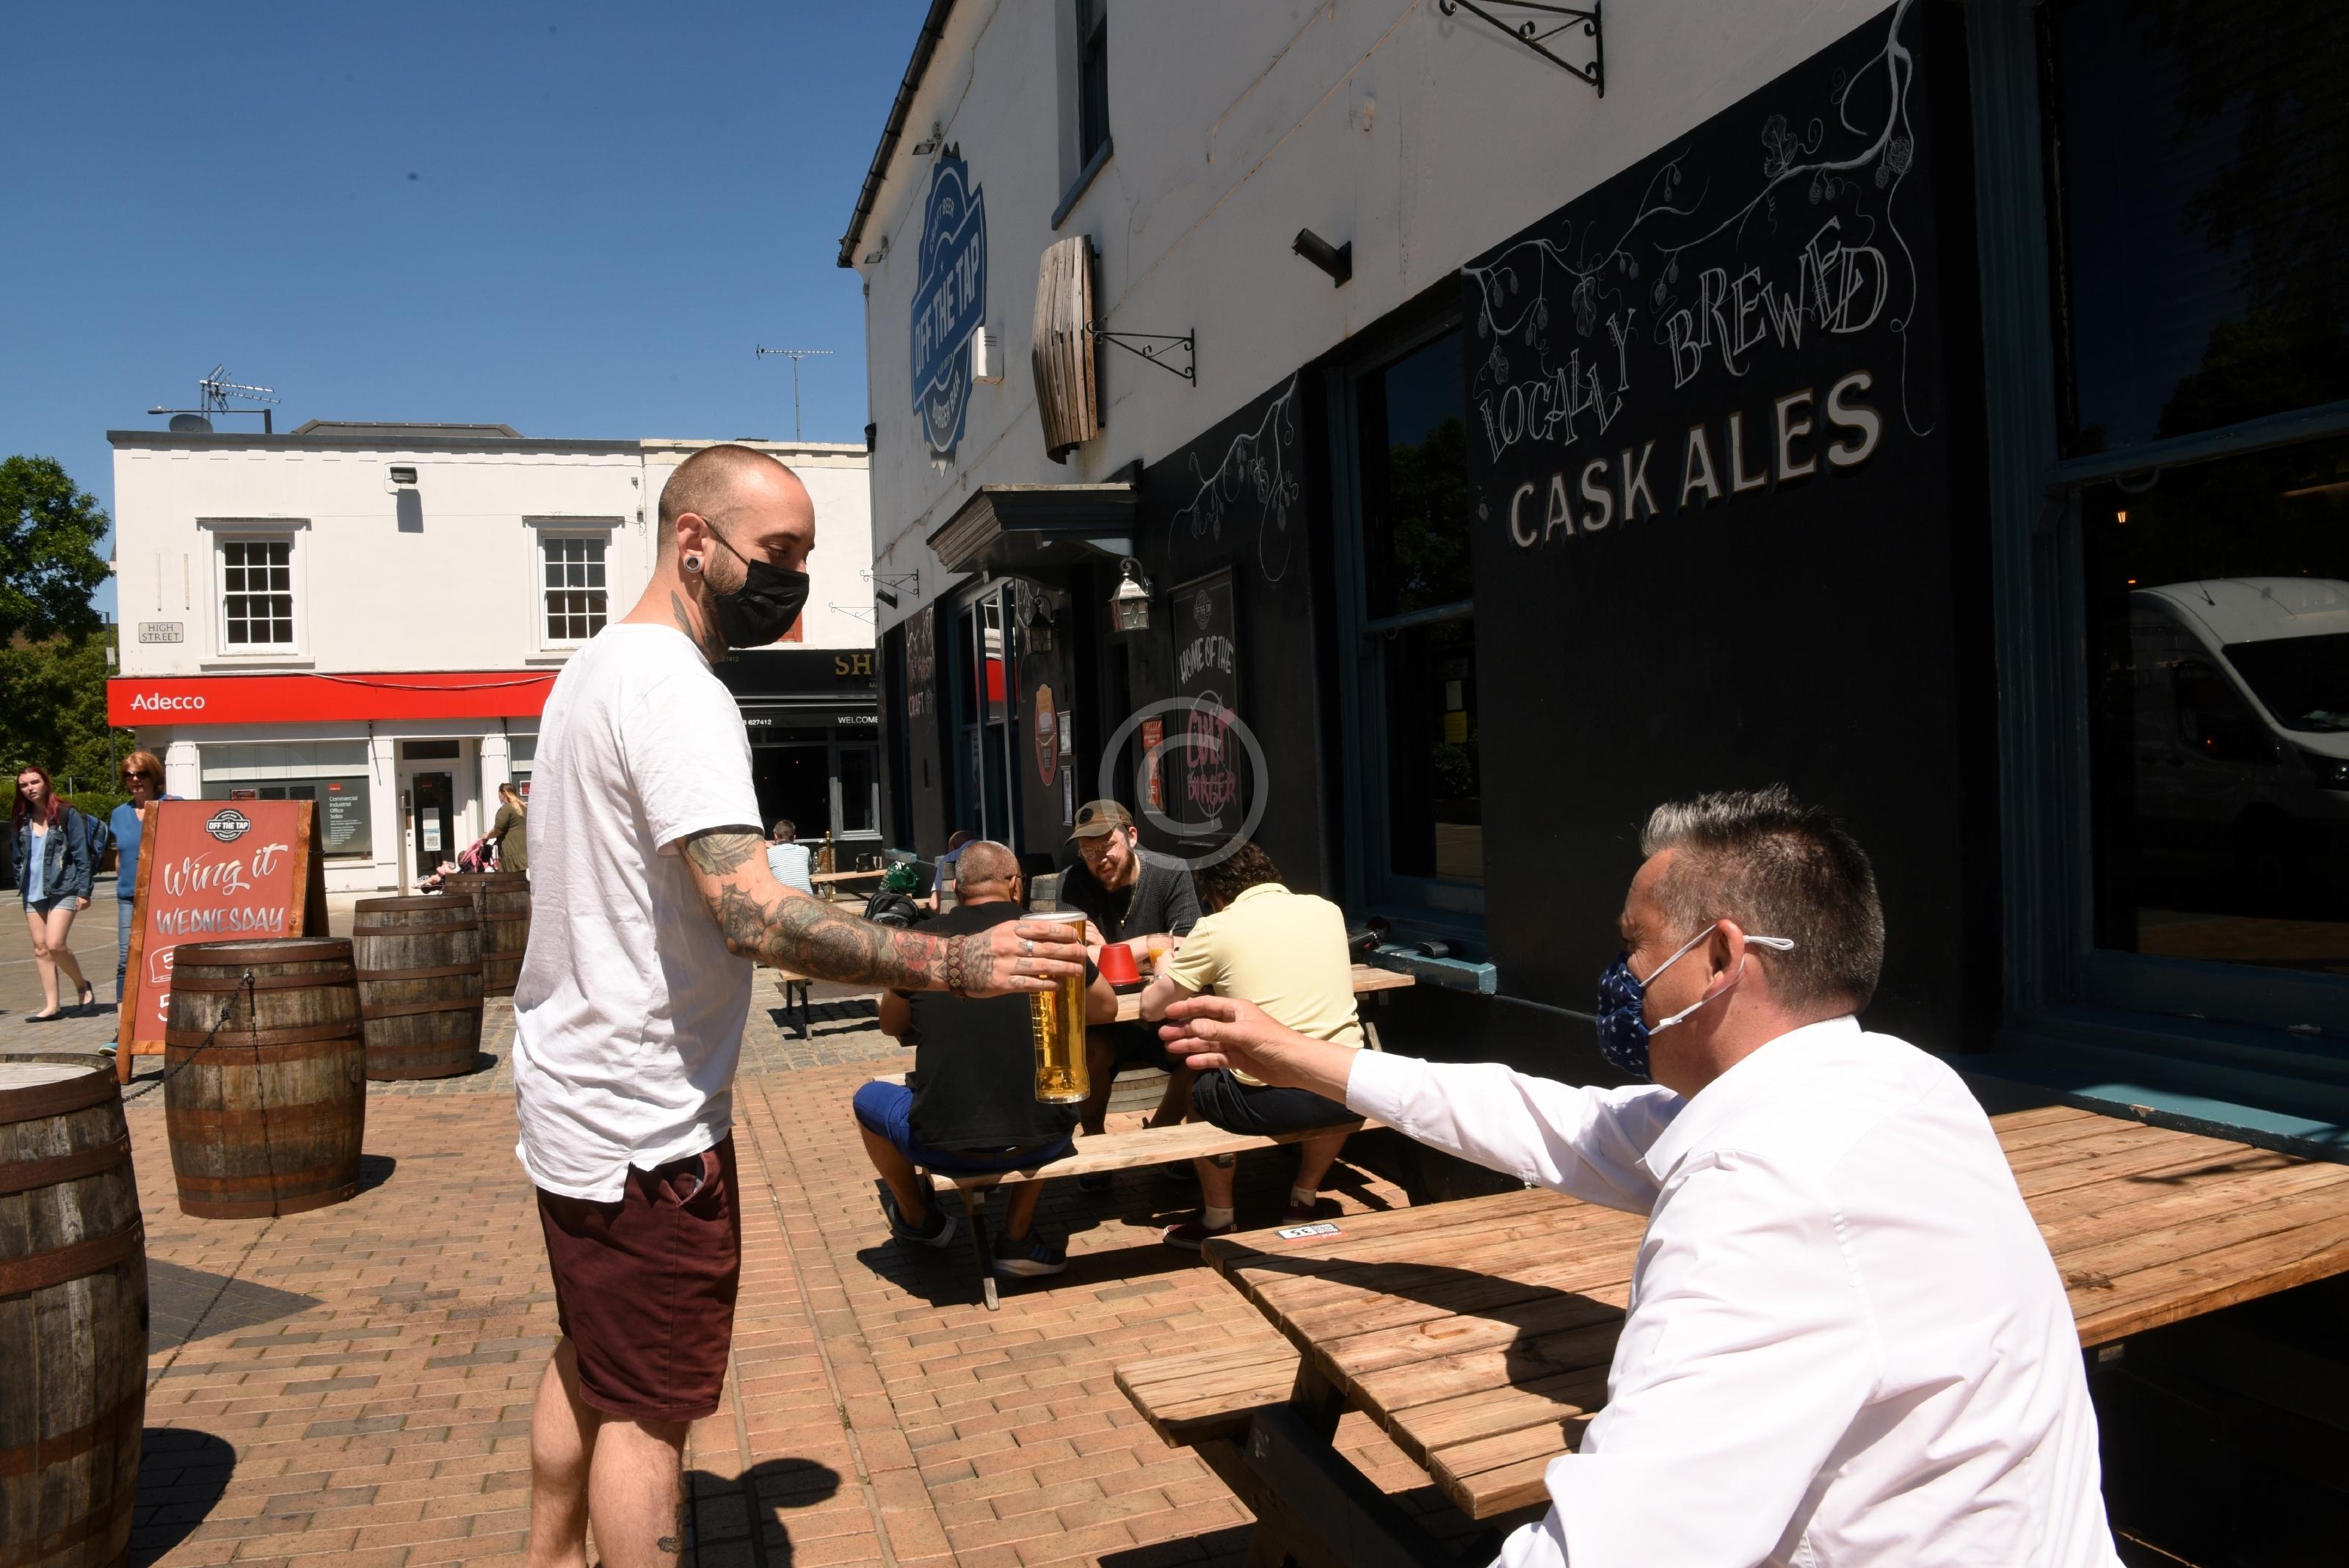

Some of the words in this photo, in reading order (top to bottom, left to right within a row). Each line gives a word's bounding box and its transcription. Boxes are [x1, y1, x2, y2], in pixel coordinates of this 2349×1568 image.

[929, 203, 942, 255] CRAFT
[943, 197, 954, 218] BEER
[915, 302, 931, 378] OFF
[933, 269, 955, 349] THE
[956, 231, 979, 317] TAP
[1480, 308, 1636, 463] LOCALLY
[1666, 217, 1888, 390] BREWED
[950, 369, 961, 414] BAR
[1510, 440, 1658, 548] CASK
[1680, 370, 1883, 508] ALES
[142, 633, 179, 641] STREET
[1180, 637, 1204, 684] HOME
[1205, 636, 1217, 667] OF
[1218, 636, 1233, 675] THE
[130, 692, 206, 711] Adecco
[838, 716, 878, 724] WELCOME
[1187, 771, 1236, 807] BURGER
[164, 852, 250, 896] Wing
[252, 843, 288, 879] it
[156, 907, 285, 936] WEDNESDAY
